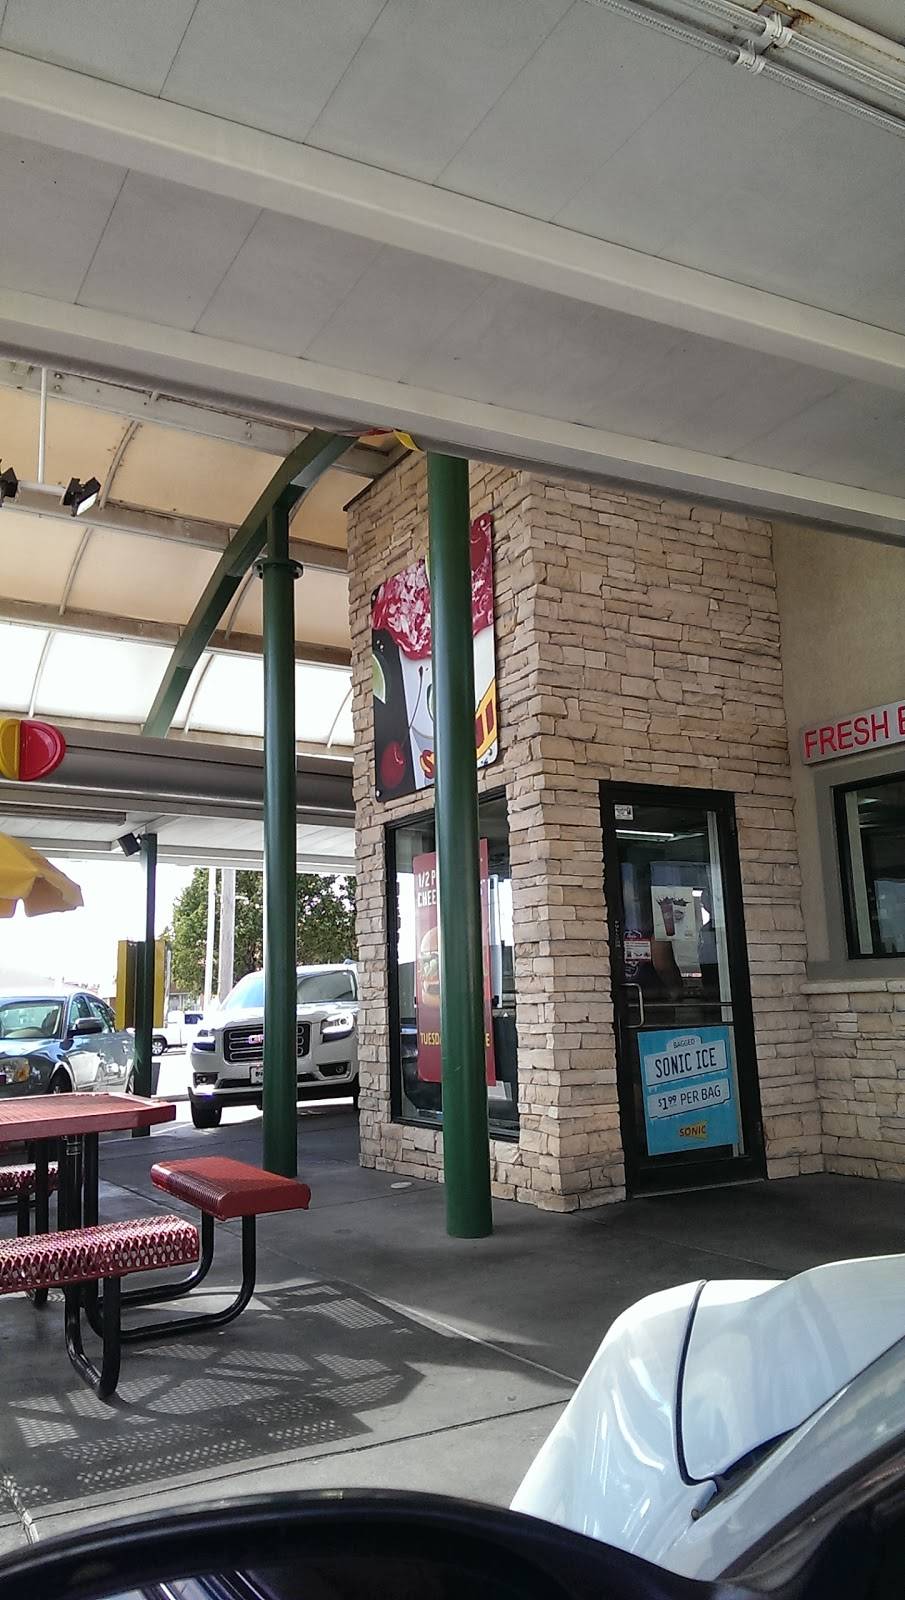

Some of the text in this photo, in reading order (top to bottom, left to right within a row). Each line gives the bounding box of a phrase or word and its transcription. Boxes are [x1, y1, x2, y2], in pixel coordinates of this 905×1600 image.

[803, 710, 890, 759] FRESH
[418, 871, 430, 888] 1/2
[417, 889, 437, 908] CHEE
[420, 1032, 441, 1046] TUESD
[655, 1047, 717, 1078] SONIC ICE
[680, 1090, 700, 1106] PER
[701, 1084, 721, 1101] BAG
[679, 1124, 706, 1137] SONIC
